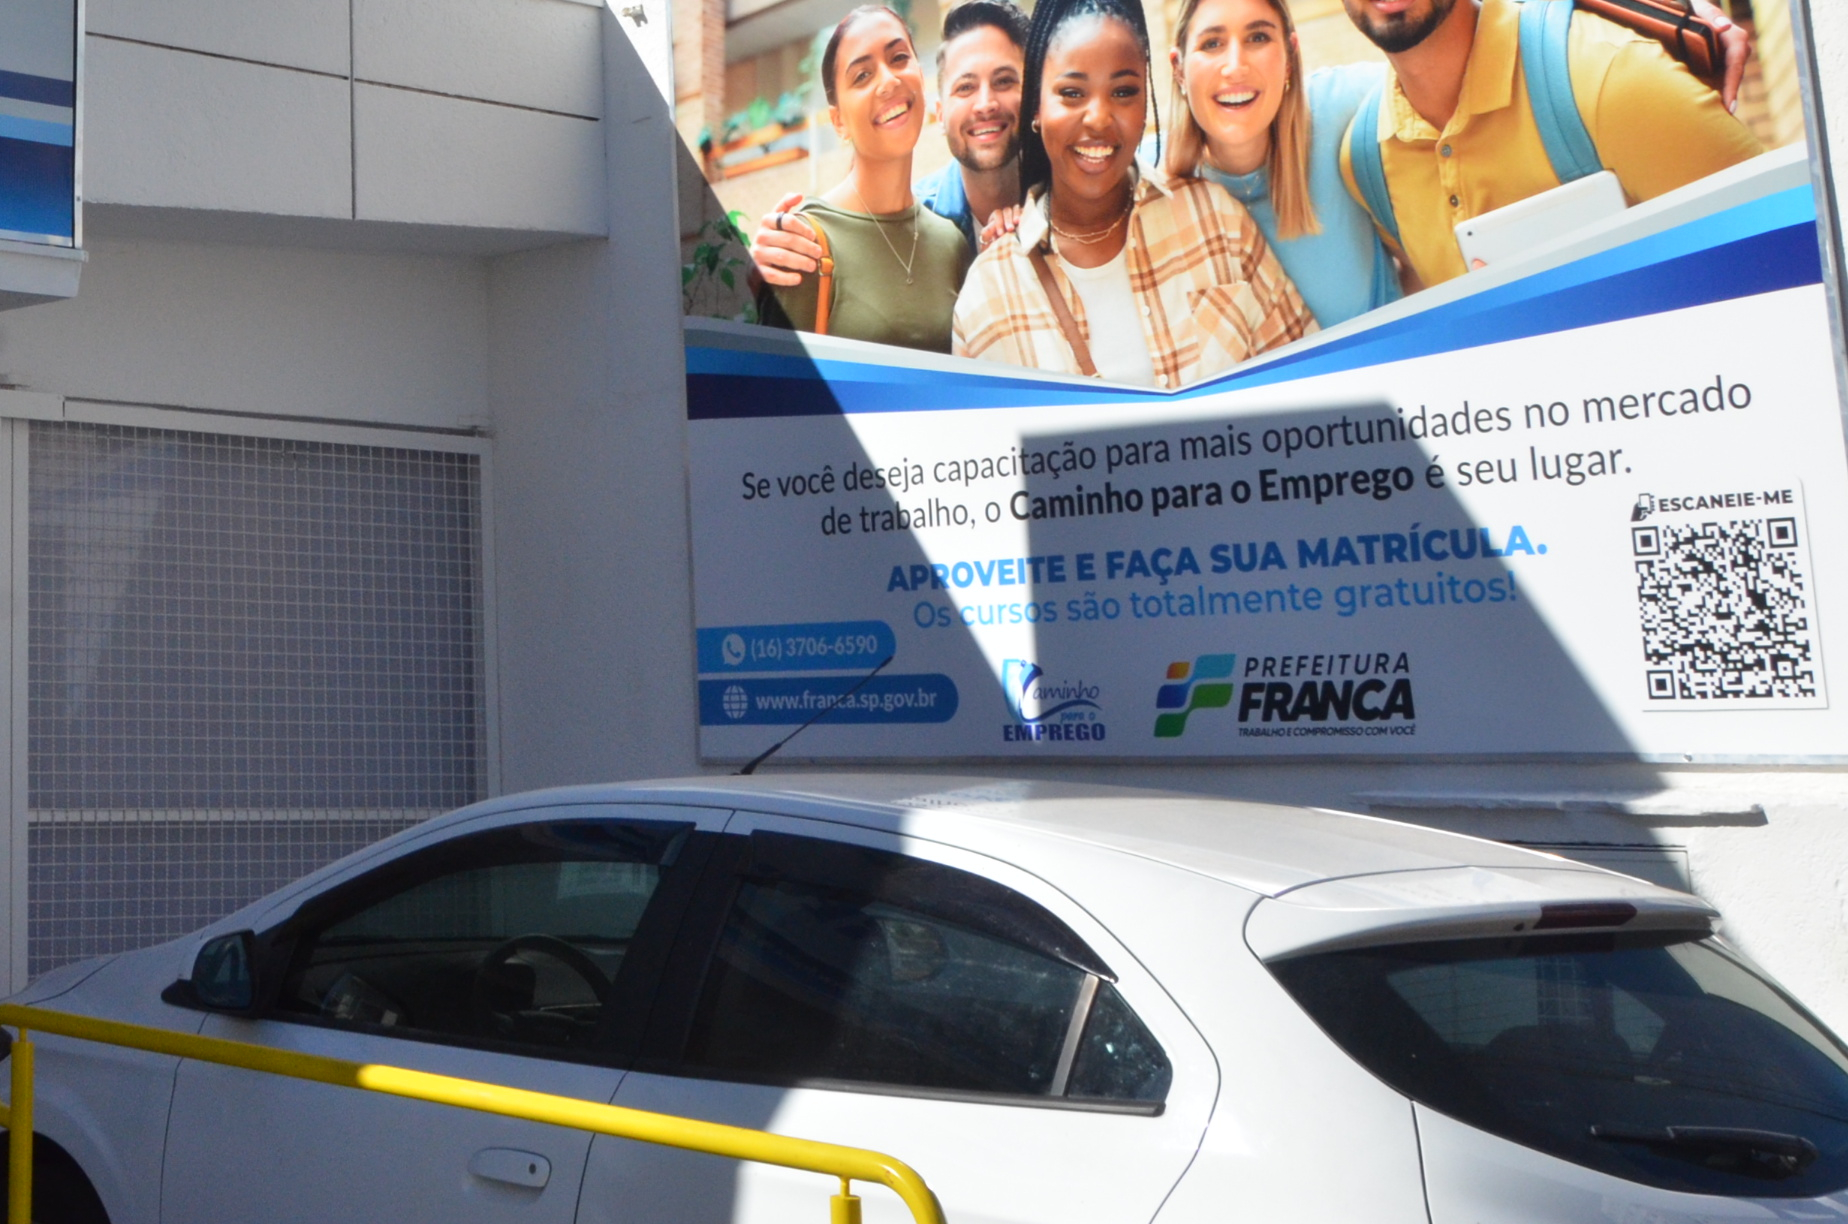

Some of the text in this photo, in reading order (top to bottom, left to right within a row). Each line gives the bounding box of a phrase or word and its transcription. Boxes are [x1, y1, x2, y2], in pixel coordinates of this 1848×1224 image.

[741, 374, 1753, 501] Se você deseja capacitação para mais oportunidades no mercado
[820, 445, 1633, 536] de trabalho, o Caminho para o Emprego é seu lugar.
[1658, 489, 1794, 513] ESCANEIE-ME
[886, 522, 1549, 593] APROVEITE E FAÇA SUA MATRÍCULA.
[912, 569, 1517, 633] Os cursos são totalmente gratuitos!
[751, 635, 878, 661] (16) 3706-6590
[1244, 651, 1410, 677] PREFEITURA
[755, 689, 938, 713] www.franca.sp.gov.br
[1238, 678, 1416, 722] FRANCA
[1060, 708, 1096, 724] para o
[1002, 722, 1106, 743] EMPREGO
[1238, 723, 1416, 737] TRABALHO E COMPROMISSO COM VOCÊ
